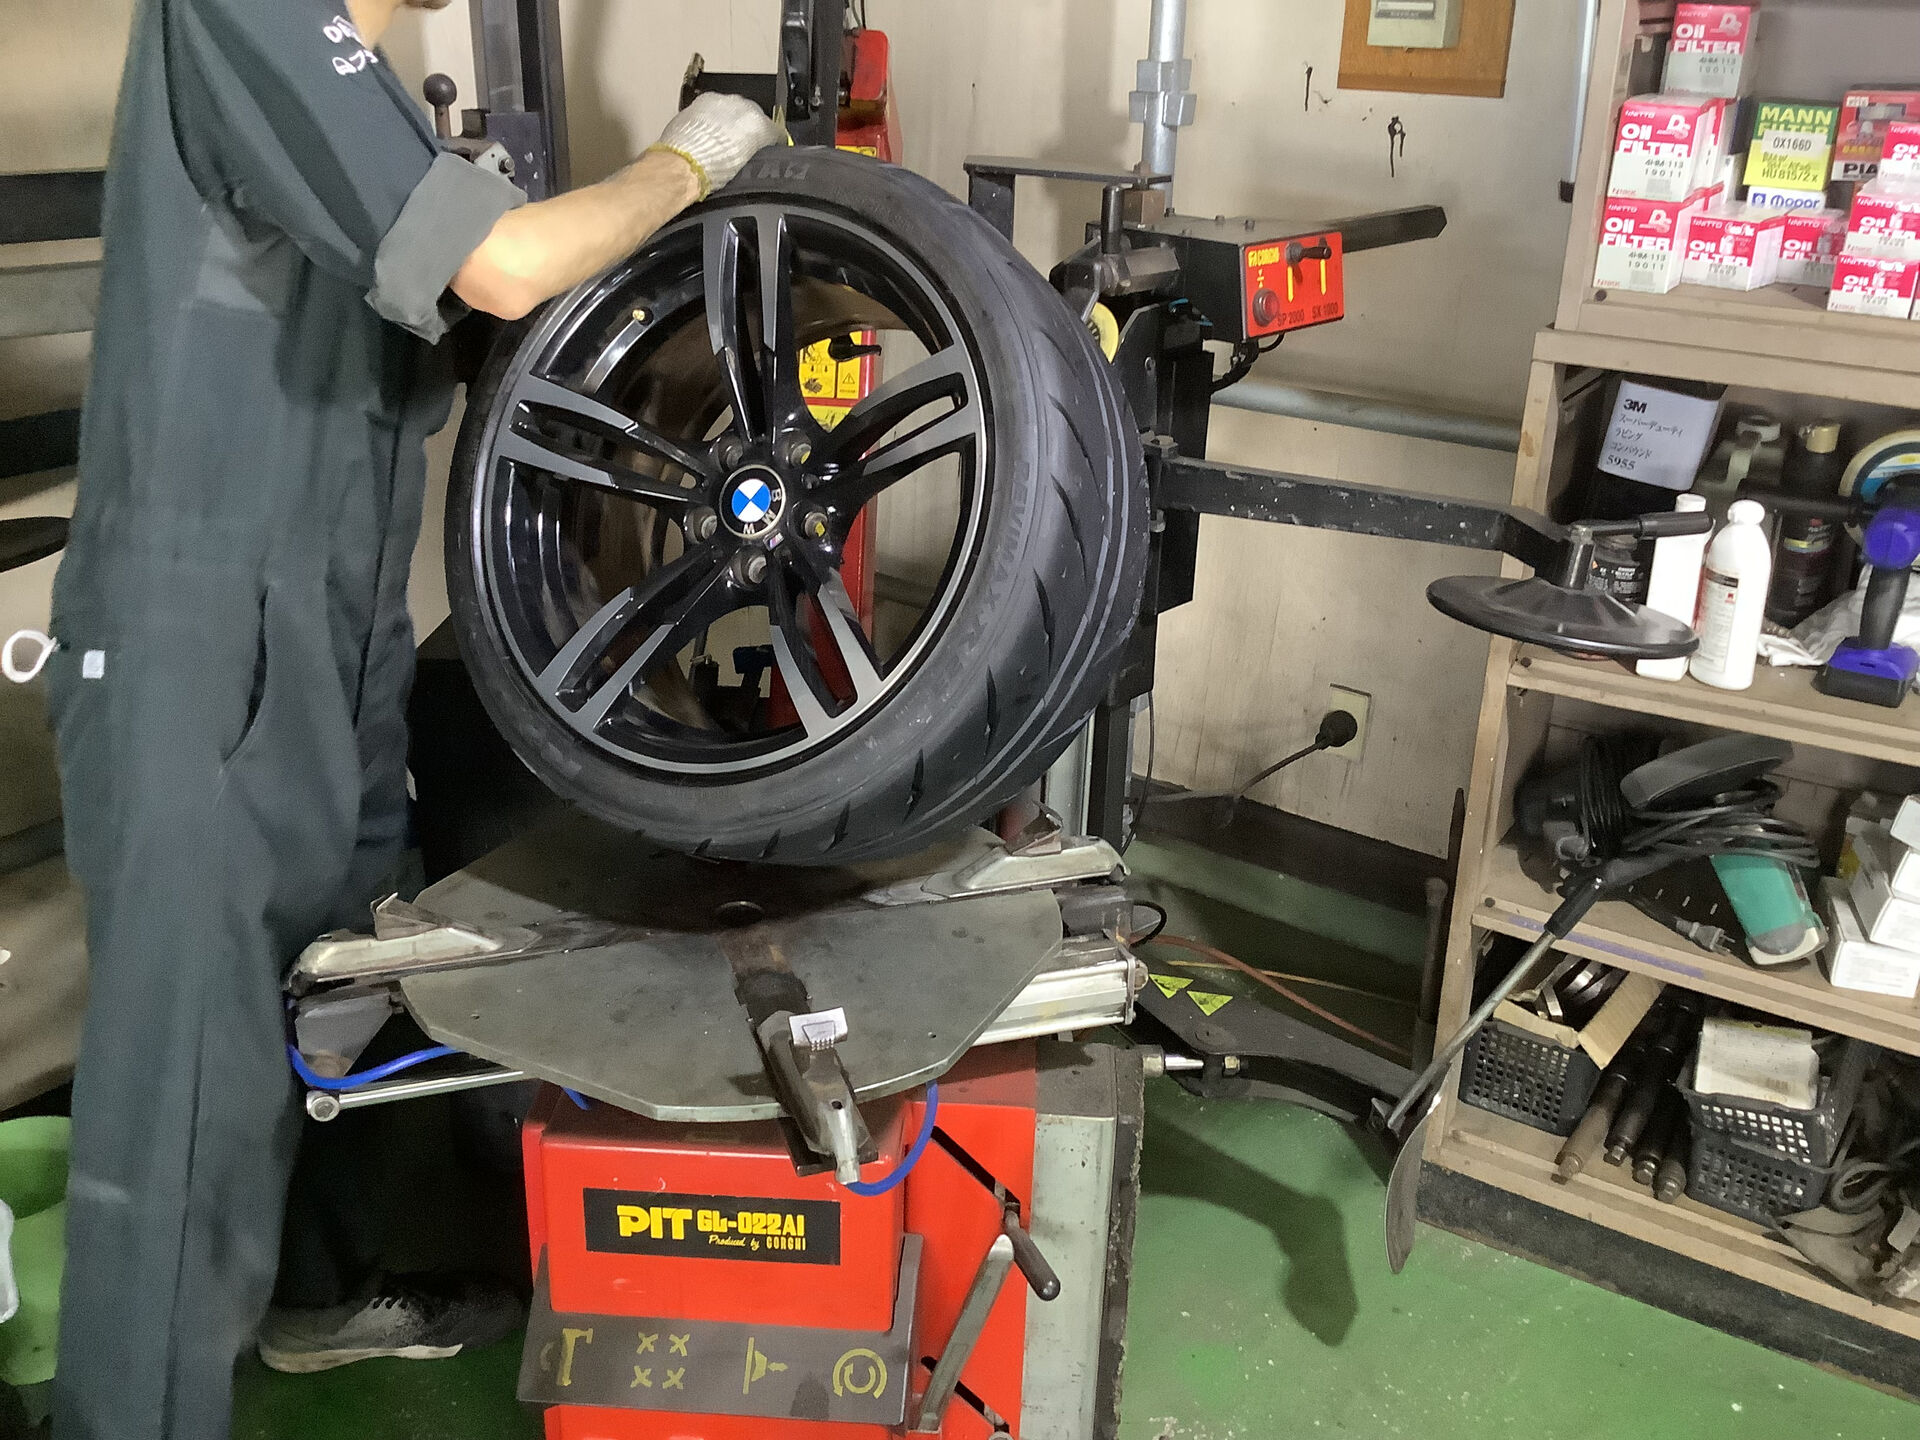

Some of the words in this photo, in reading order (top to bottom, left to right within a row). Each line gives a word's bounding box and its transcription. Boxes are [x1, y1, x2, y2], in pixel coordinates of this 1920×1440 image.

[1674, 40, 1740, 55] FILTER
[1761, 106, 1832, 125] MANN
[1619, 140, 1688, 156] FILTER
[1603, 233, 1671, 250] FILTER
[1688, 251, 1748, 267] FILTER
[1841, 284, 1899, 299] FILTER
[1624, 399, 1647, 413] 3M
[1616, 427, 1644, 440] ラビング
[1606, 455, 1635, 470] 5955
[743, 488, 782, 534] BMW
[616, 1205, 692, 1240] PIT
[709, 1234, 746, 1248] Produced
[750, 1237, 759, 1251] by
[766, 1237, 806, 1250] CORGHI
